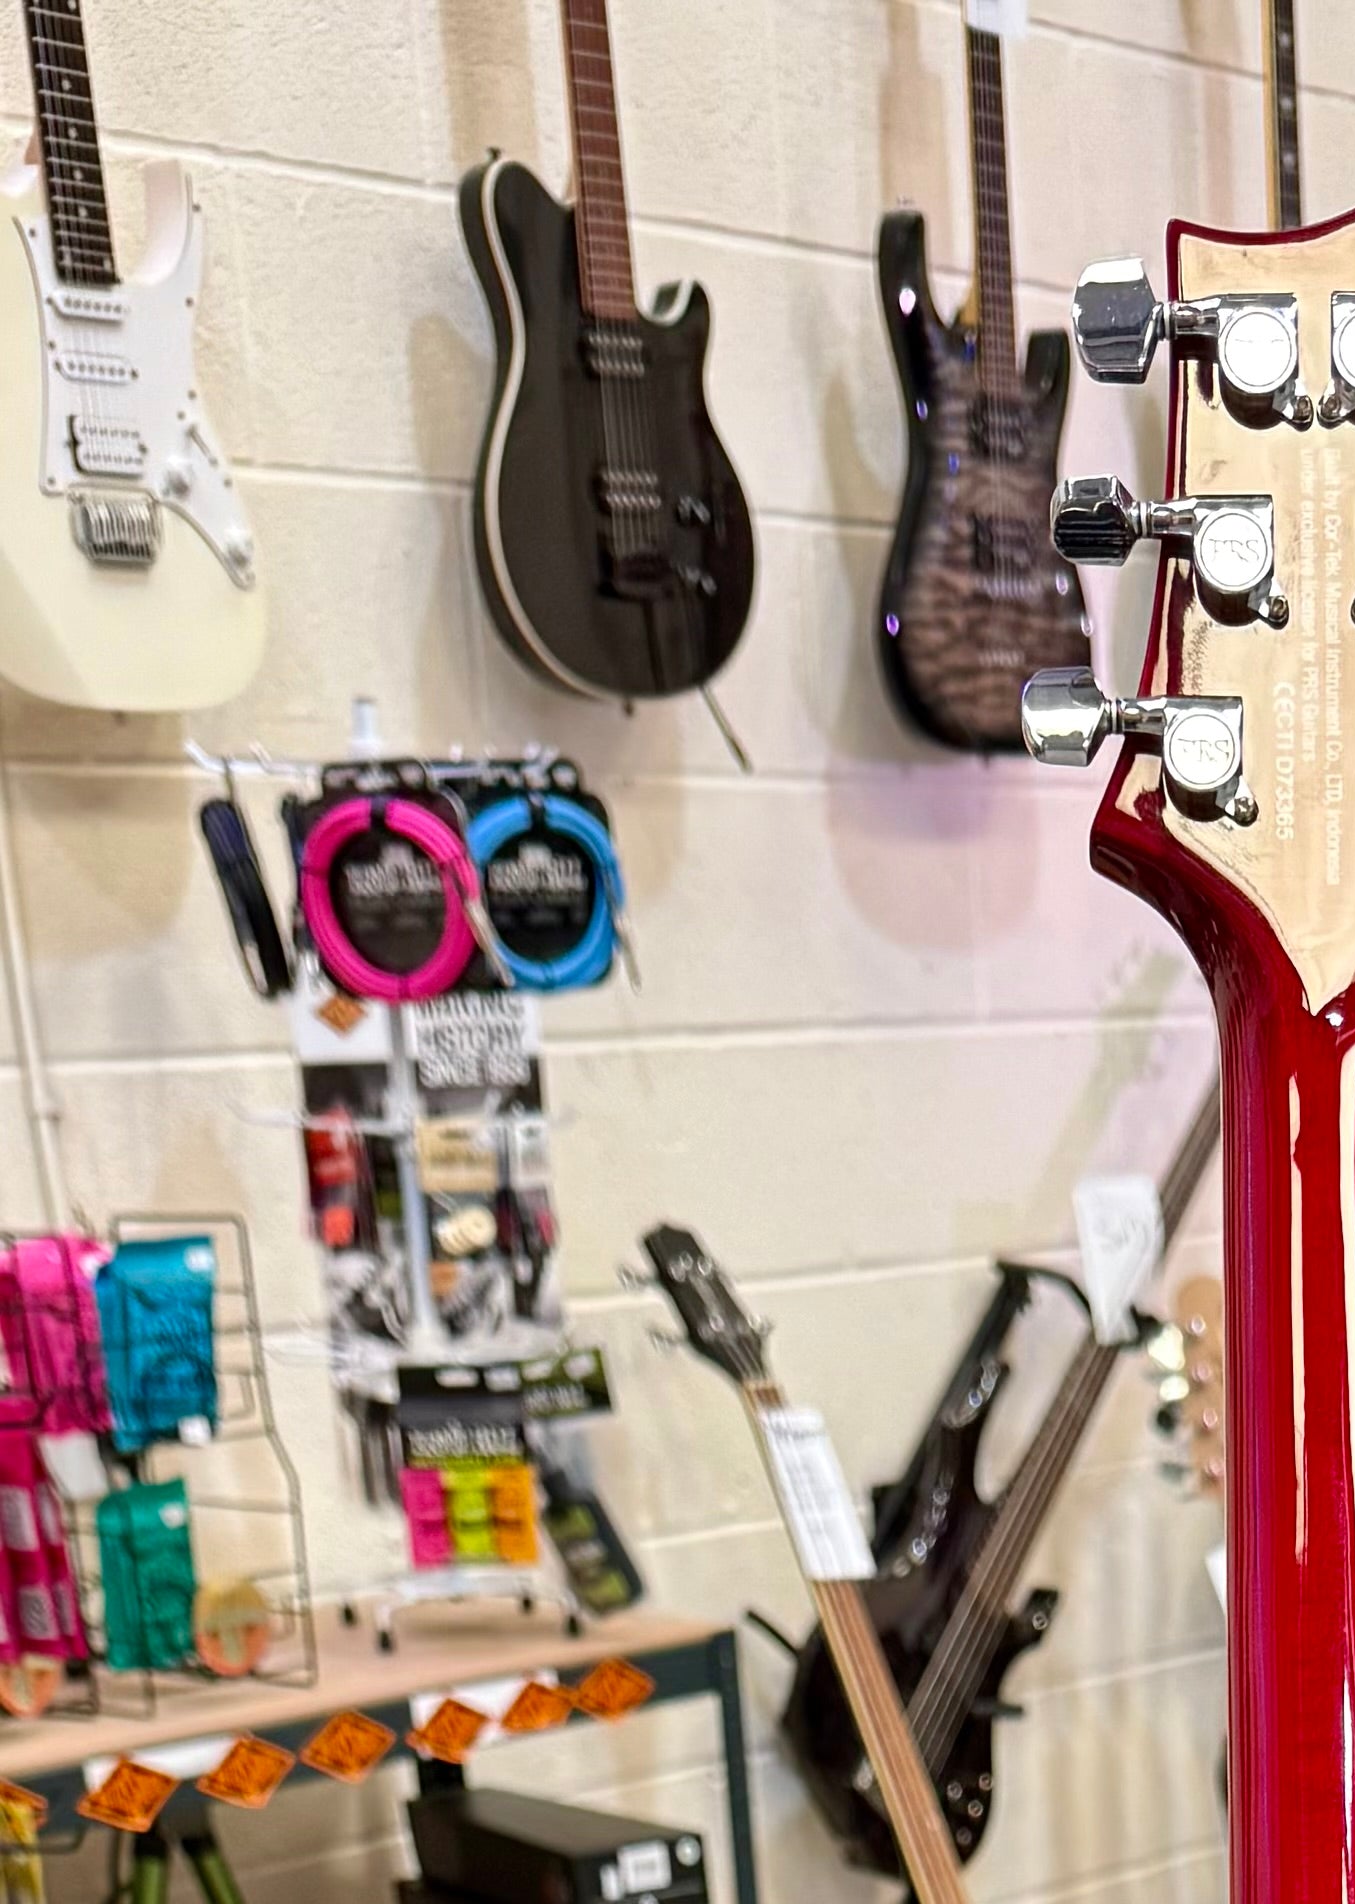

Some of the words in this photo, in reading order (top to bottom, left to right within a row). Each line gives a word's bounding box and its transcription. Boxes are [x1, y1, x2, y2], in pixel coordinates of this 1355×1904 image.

[1301, 449, 1317, 494] under
[1321, 491, 1341, 510] by
[1301, 500, 1318, 577] exclusive
[1324, 582, 1342, 643] Musical
[1303, 641, 1319, 664] for
[1302, 667, 1318, 700] PRS
[1325, 649, 1342, 736] Instrument
[1302, 704, 1320, 763] Guitars
[1325, 809, 1342, 886] Indonesia
